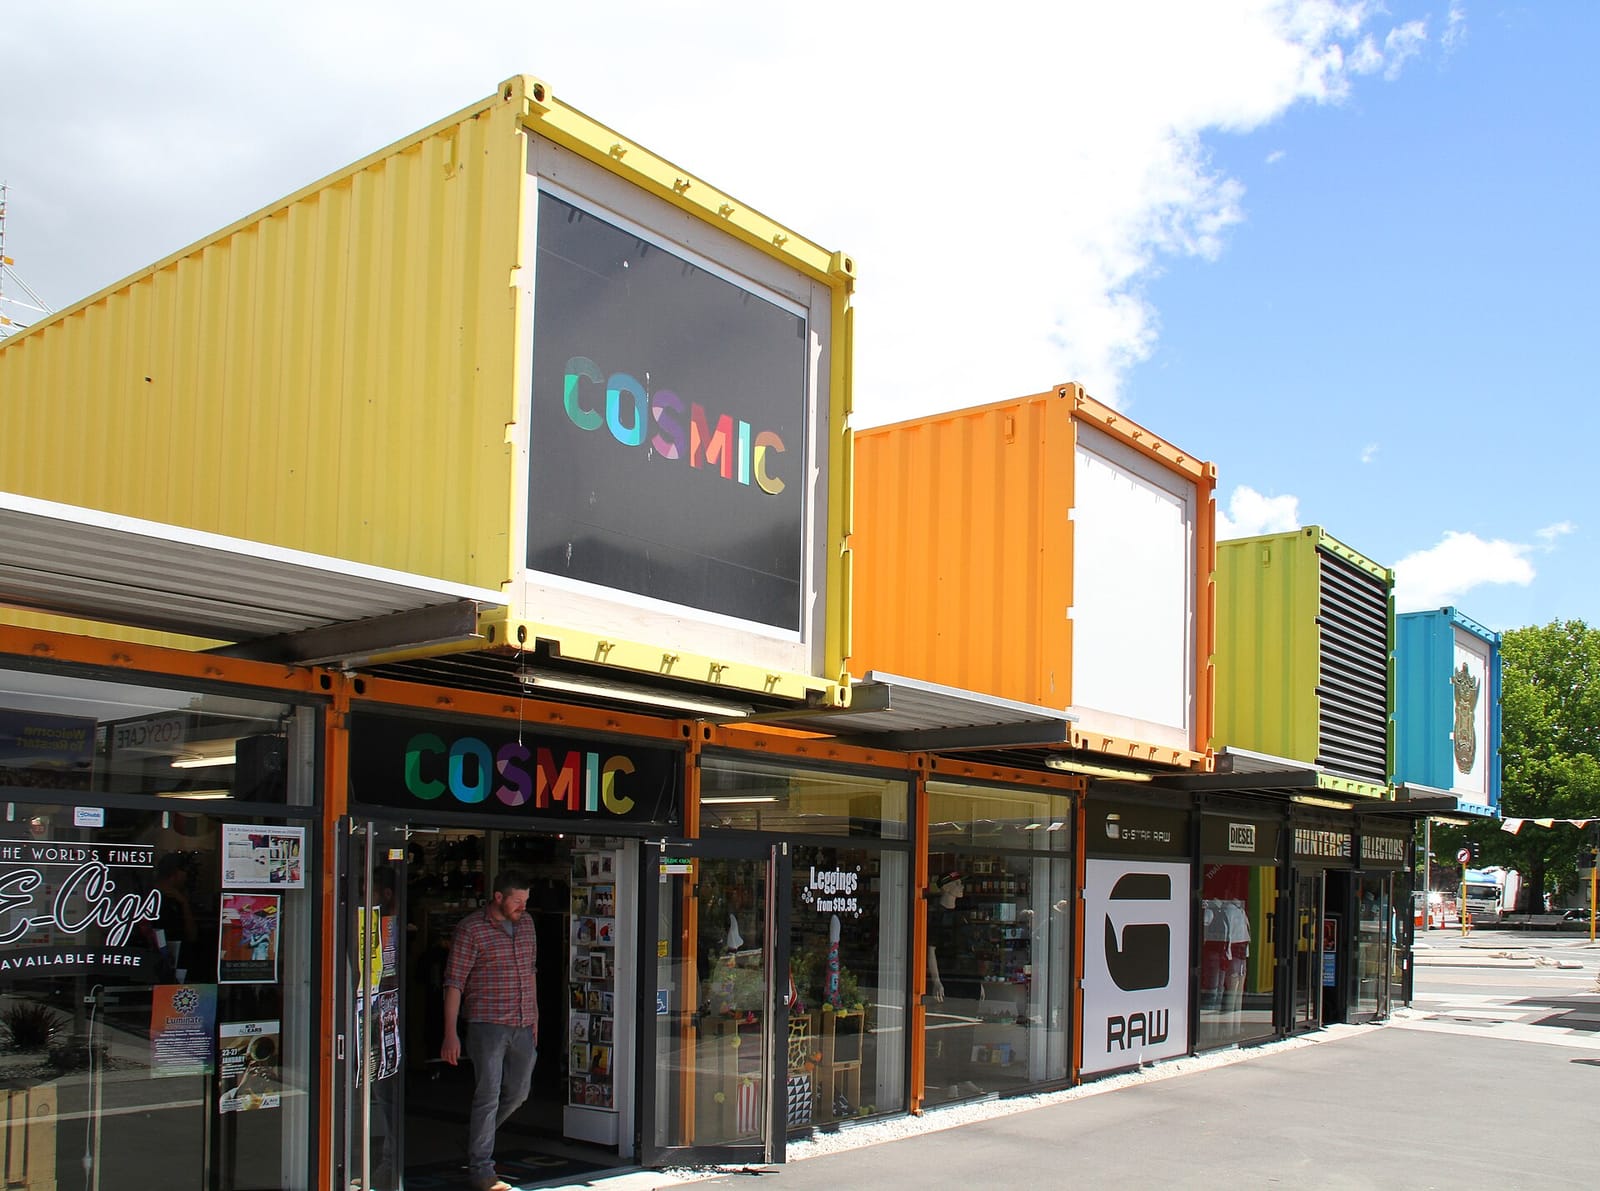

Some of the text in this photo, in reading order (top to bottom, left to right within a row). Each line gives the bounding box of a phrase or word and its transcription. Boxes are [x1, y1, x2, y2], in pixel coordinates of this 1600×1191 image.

[563, 356, 785, 495] COSMIC
[404, 733, 635, 815] COSMIC
[1153, 831, 1171, 843] RAW
[1230, 827, 1253, 845] DIESEL
[1294, 828, 1404, 861] HUNTERS AND OLLECTORS
[2, 847, 153, 863] HE WORLD'S FINEST
[810, 866, 858, 895] Leggings
[0, 861, 161, 947] E-Cigs
[816, 897, 857, 912] from $19.95
[0, 953, 142, 970] AVAILABLE HERE
[1106, 1009, 1169, 1053] RAW
